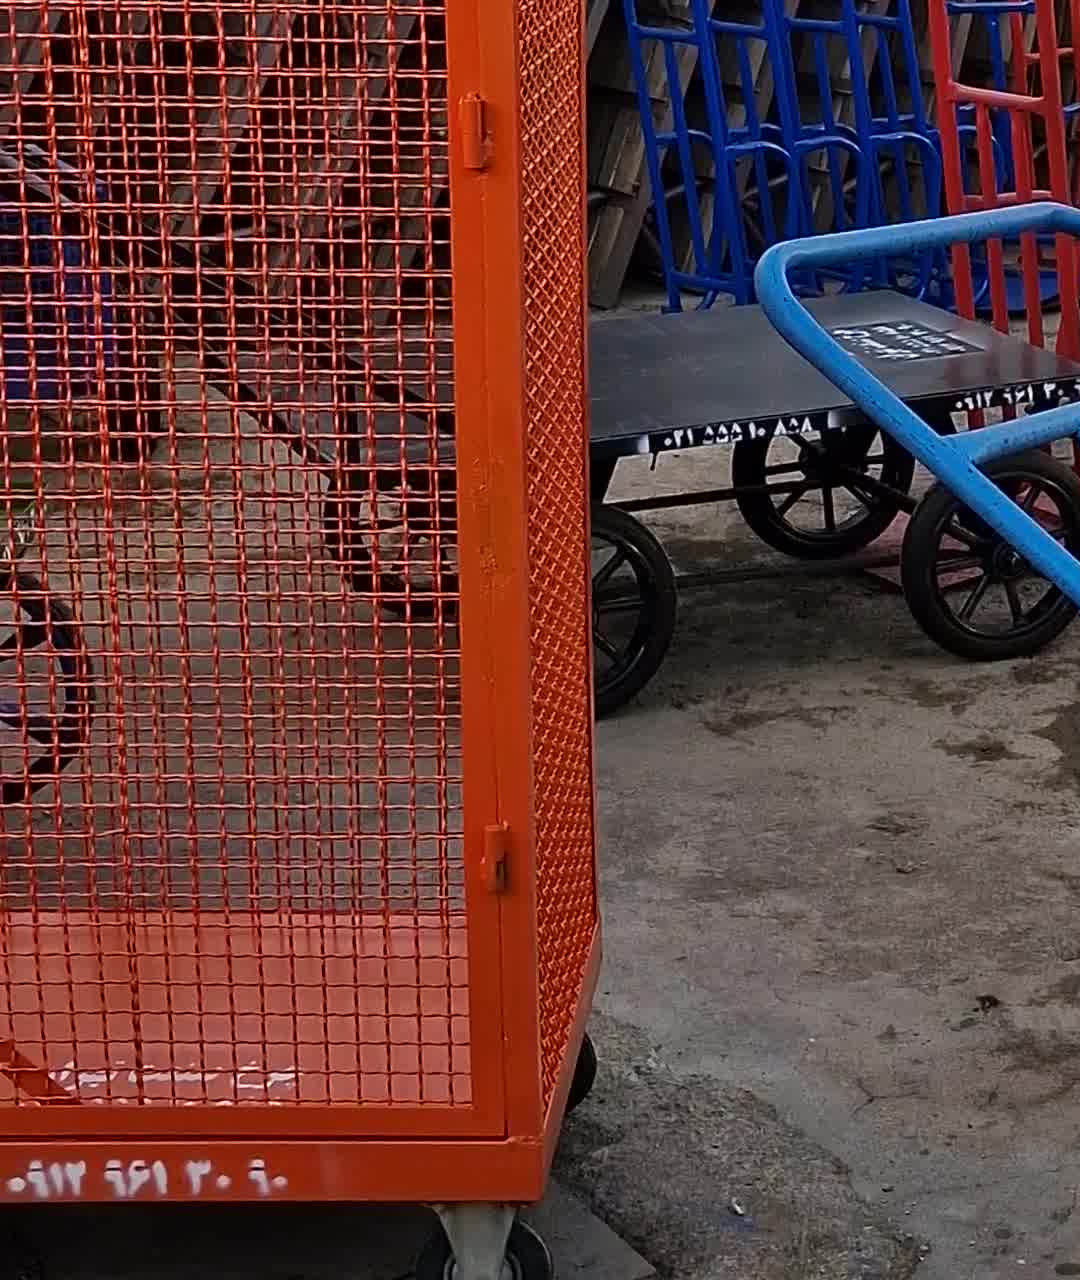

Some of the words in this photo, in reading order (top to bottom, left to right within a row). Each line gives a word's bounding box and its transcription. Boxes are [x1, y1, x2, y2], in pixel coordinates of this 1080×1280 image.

[663, 427, 694, 447] ۰۲۱
[103, 1159, 169, 1198] ۹۶۱
[184, 1159, 232, 1197] ۳۰
[247, 1158, 289, 1198] ۹۰
